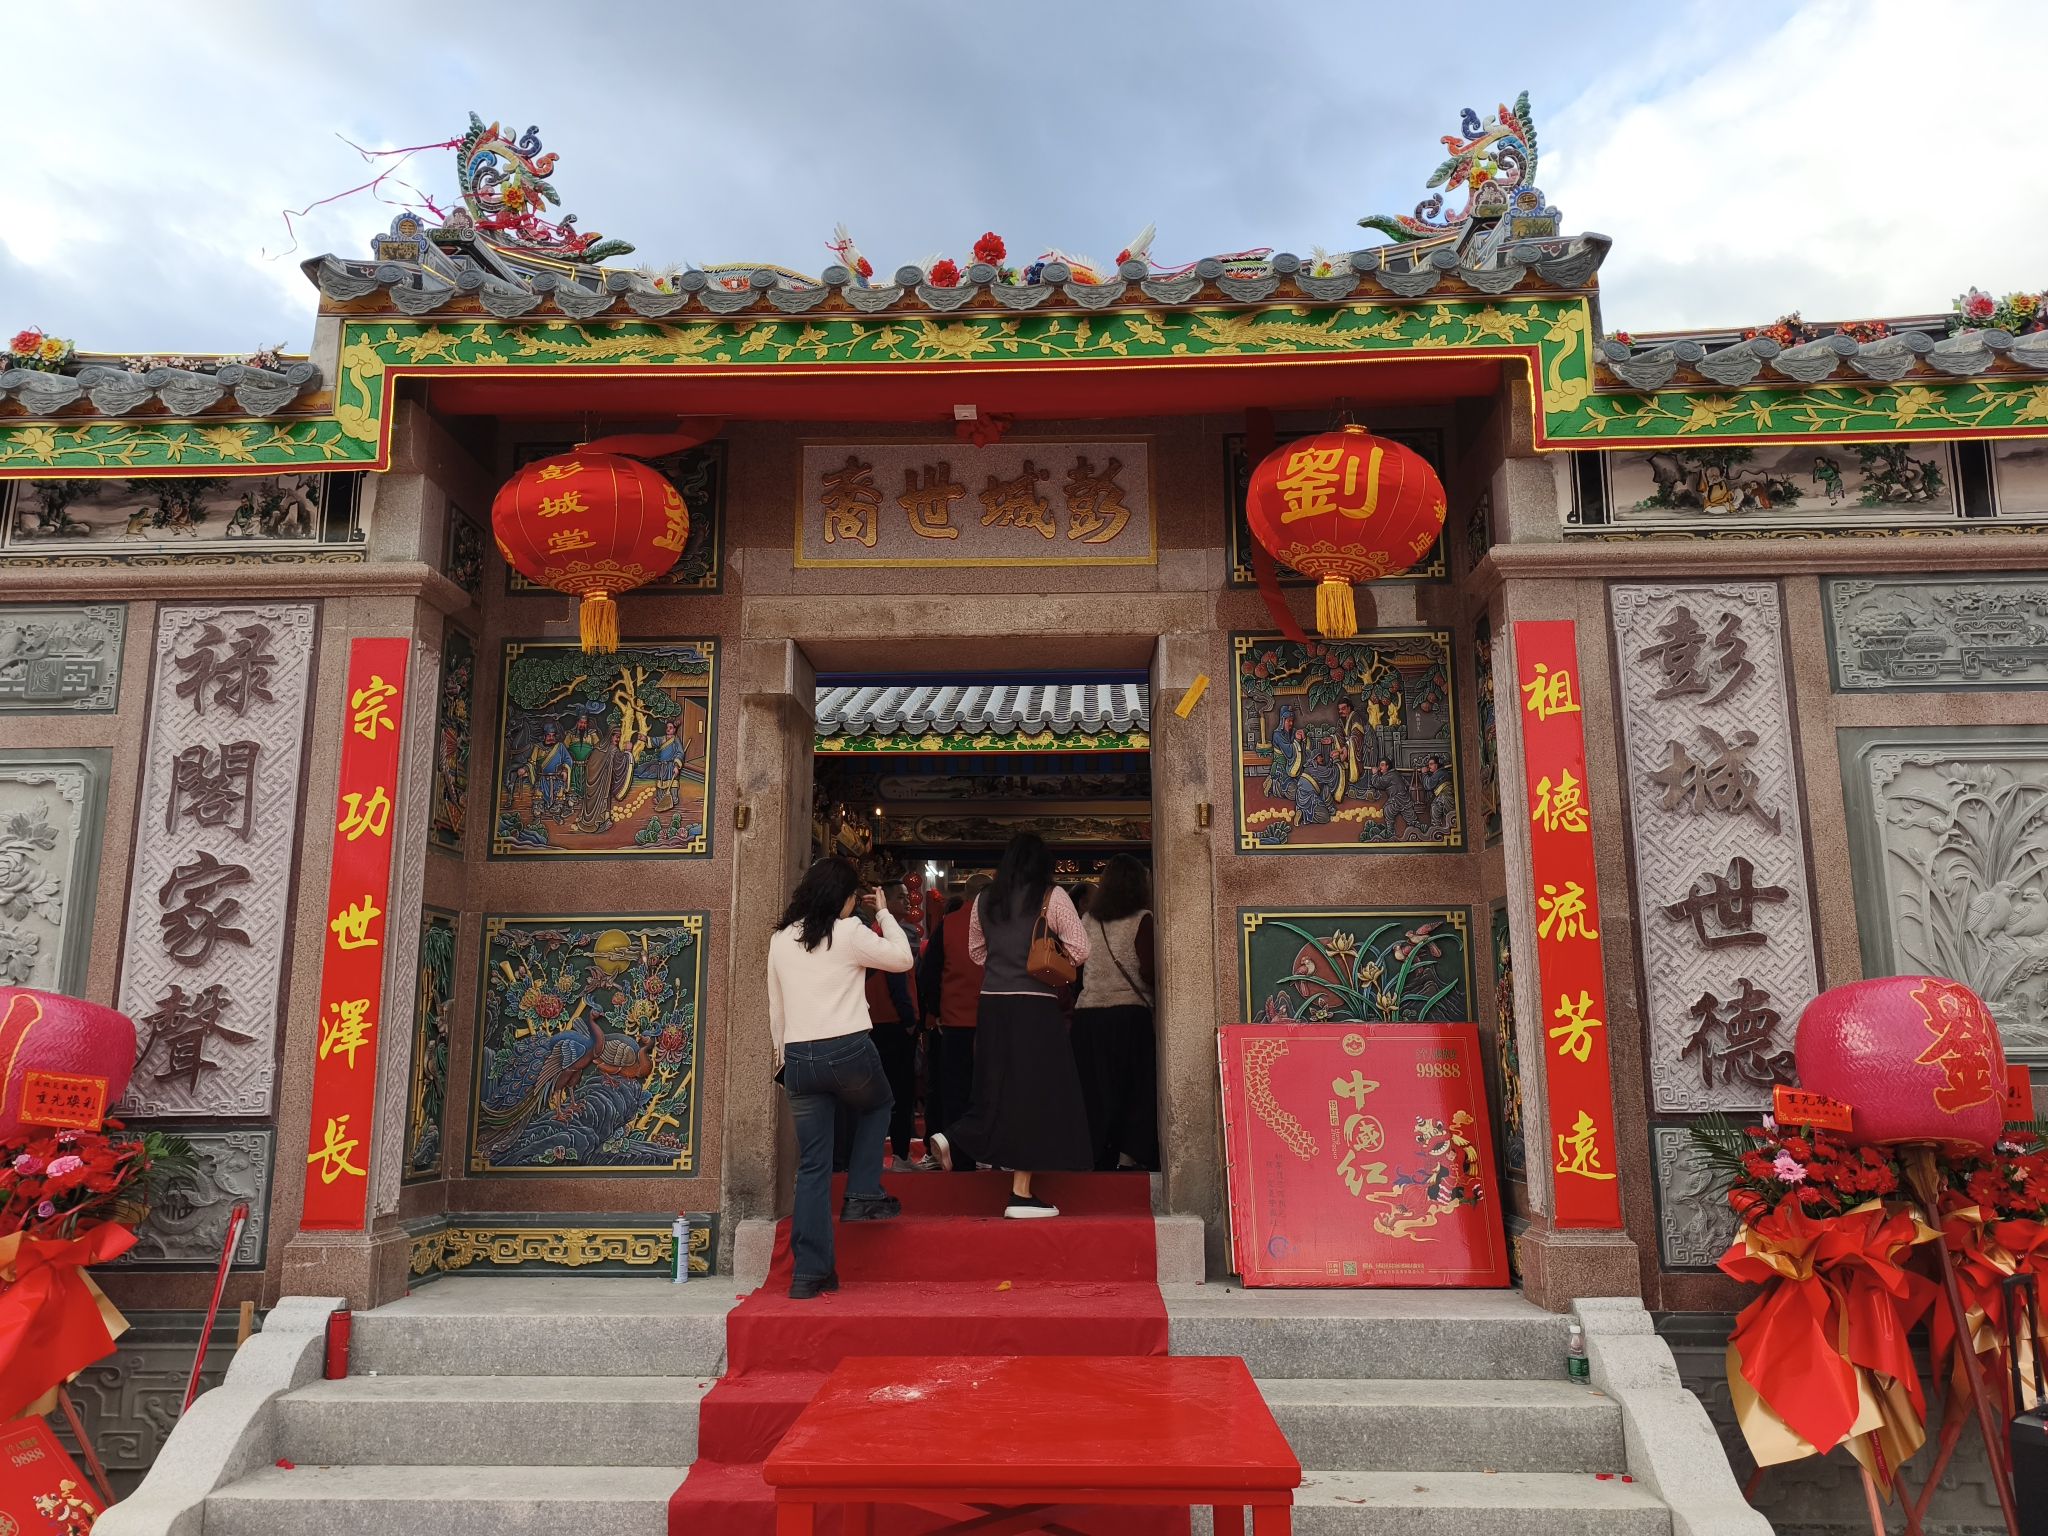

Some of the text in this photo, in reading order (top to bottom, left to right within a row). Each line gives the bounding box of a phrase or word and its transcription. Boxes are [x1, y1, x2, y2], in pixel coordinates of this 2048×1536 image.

[536, 460, 597, 555] 彭城堂
[1277, 447, 1384, 524] 劉
[1638, 605, 1796, 1091] 彭城世德
[307, 675, 396, 1184] 宗功世澤長
[1521, 663, 1616, 1180] 祖德流芳遠
[1416, 1062, 1461, 1078] 99888
[11, 1447, 46, 1468] 9888
